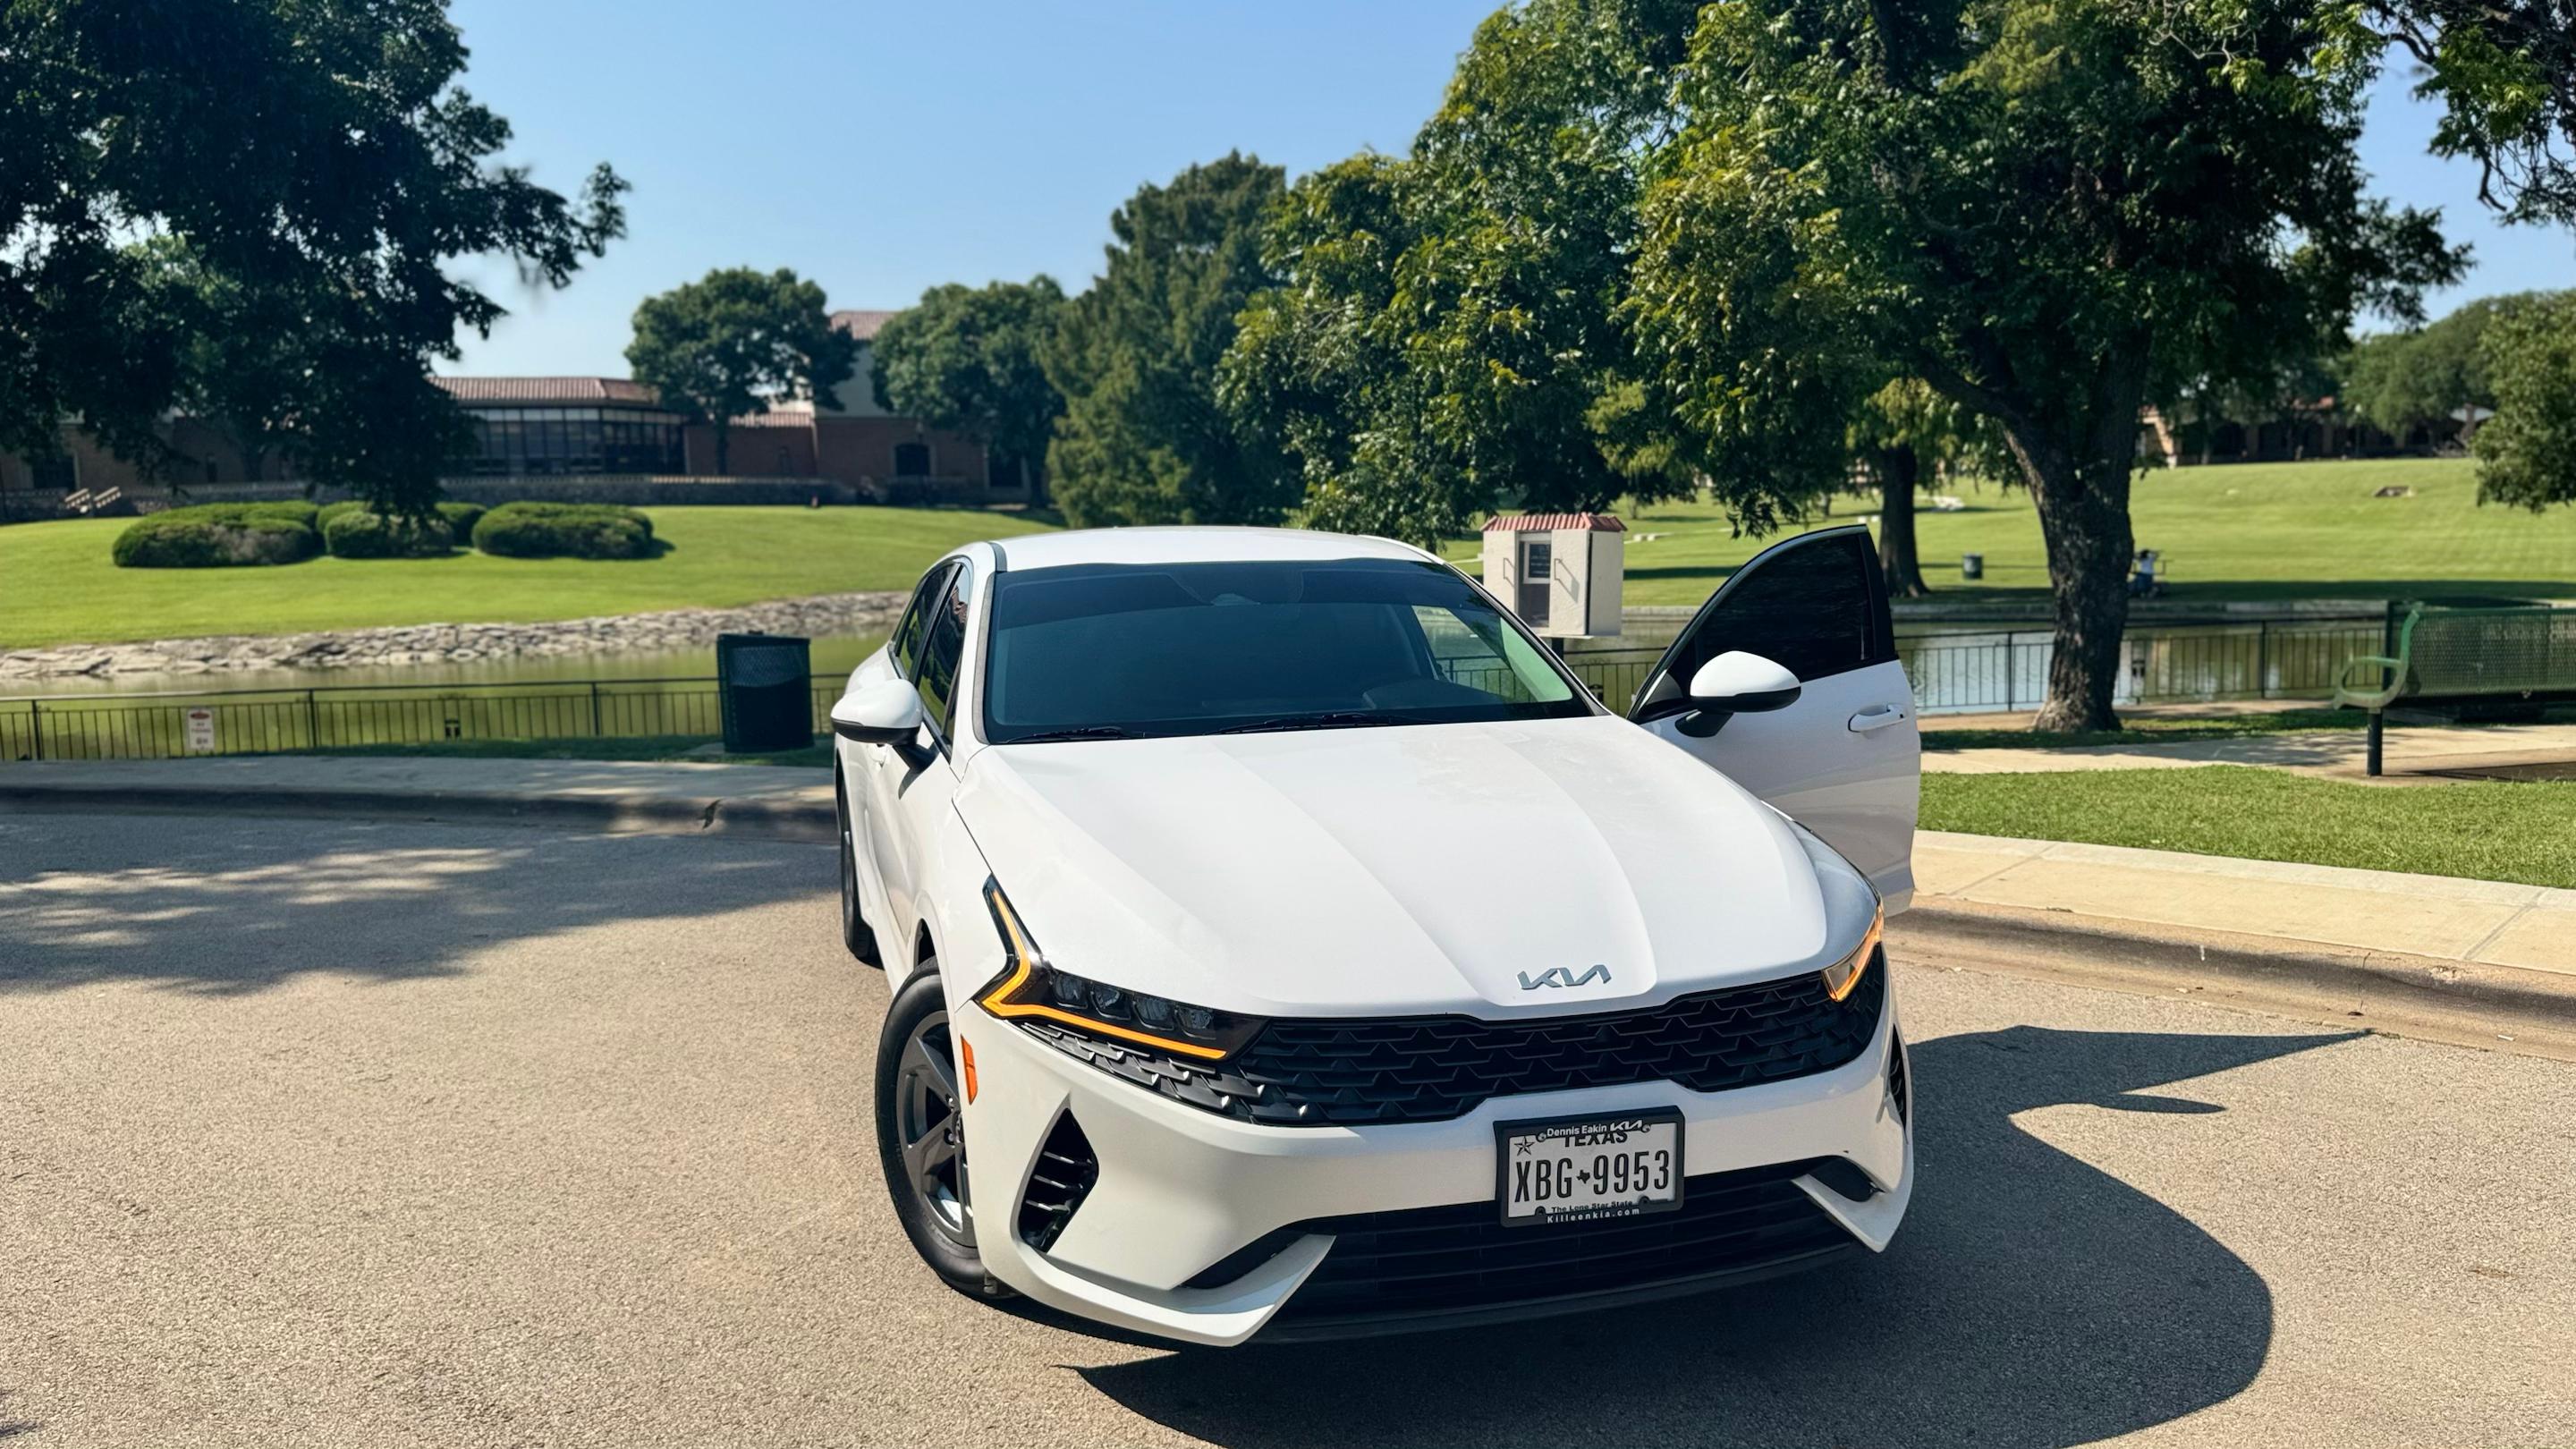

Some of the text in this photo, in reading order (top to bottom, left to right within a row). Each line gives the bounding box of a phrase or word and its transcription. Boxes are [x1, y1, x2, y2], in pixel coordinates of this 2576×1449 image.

[1517, 965, 1612, 990] KIA
[1546, 1119, 1643, 1137] Dennis Eakin KIA
[1564, 1131, 1628, 1148] TEXAS
[1514, 1149, 1670, 1203] XBG 9953
[1551, 1199, 1633, 1214] The Lone Star State
[1546, 1208, 1640, 1224] Killeenkia.com
